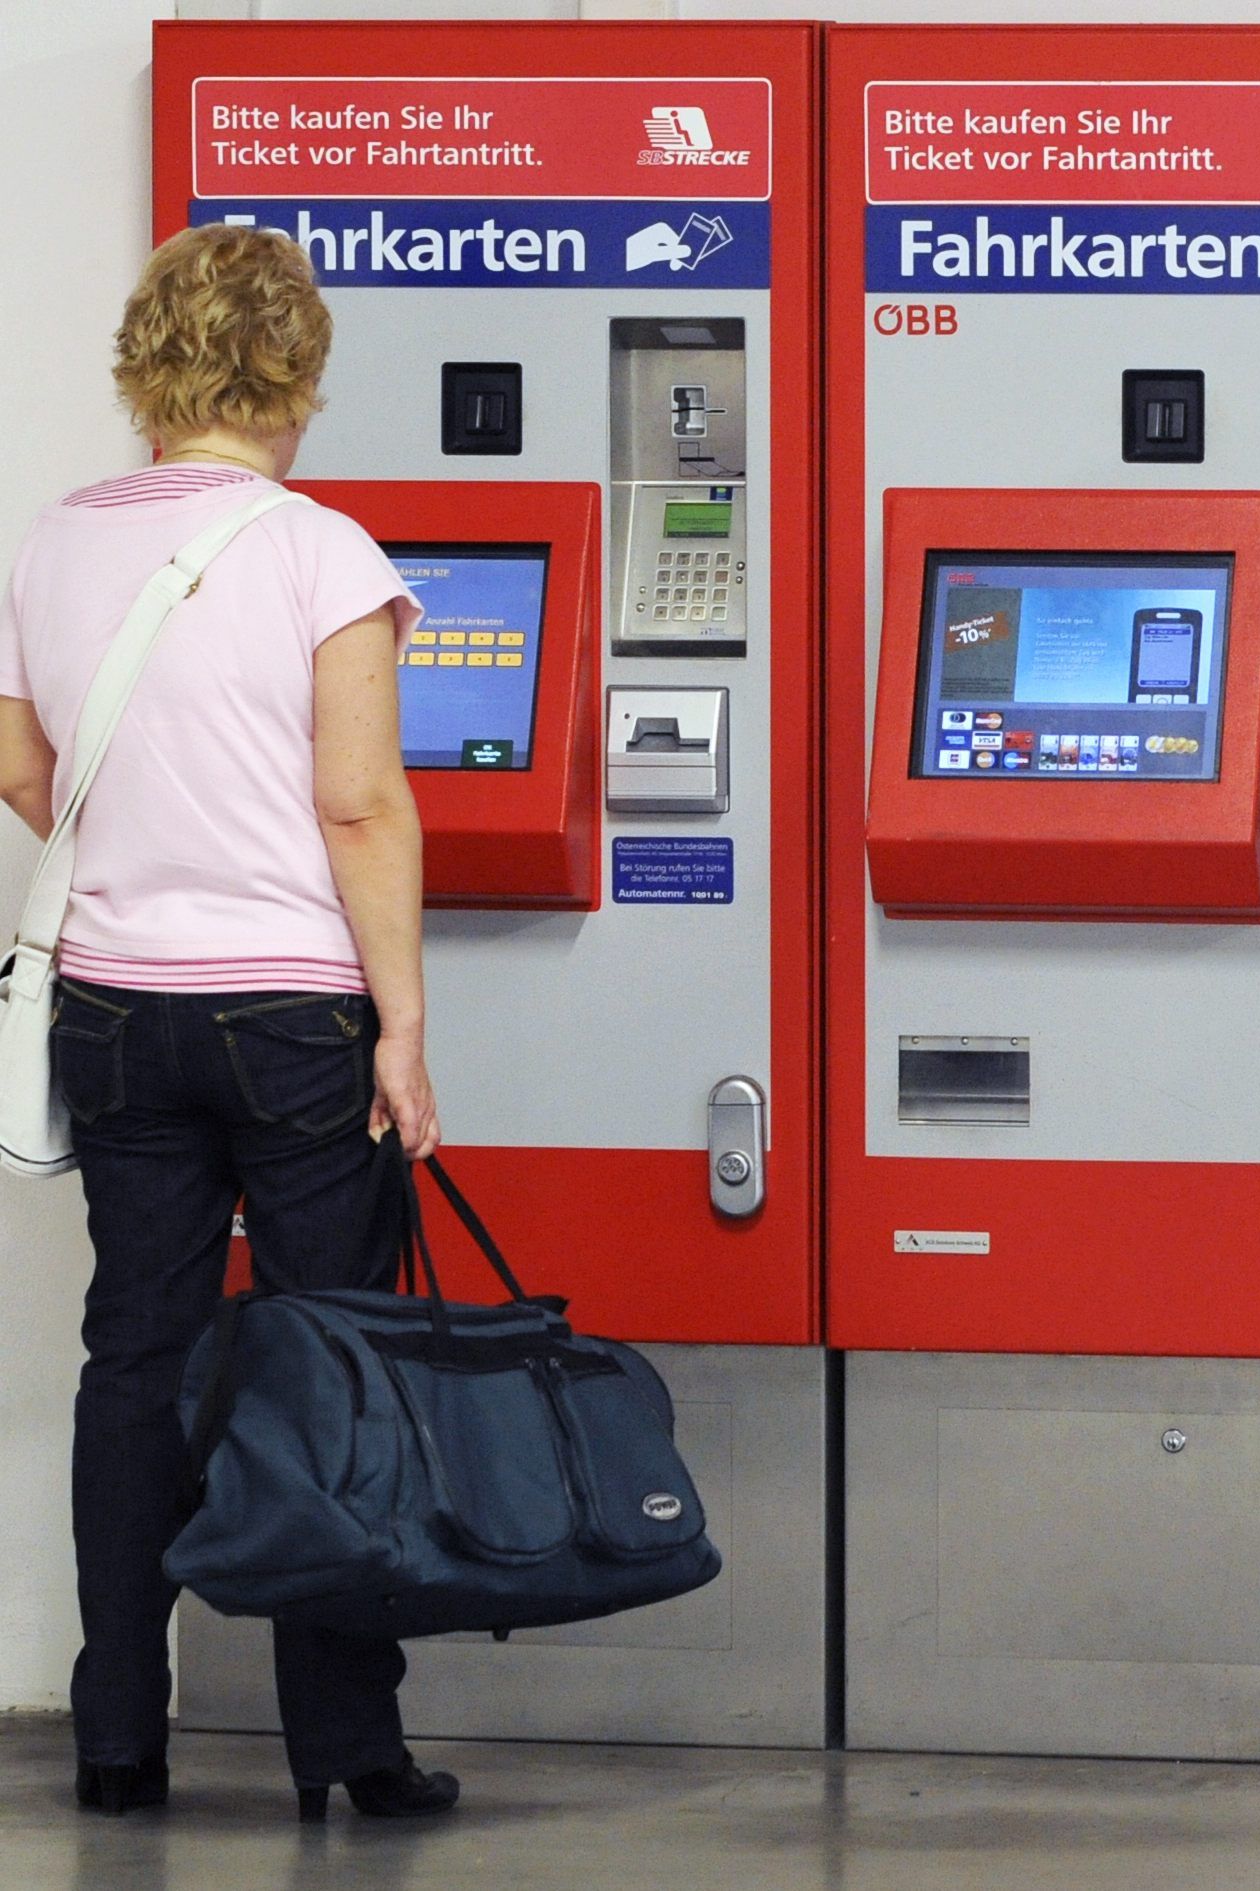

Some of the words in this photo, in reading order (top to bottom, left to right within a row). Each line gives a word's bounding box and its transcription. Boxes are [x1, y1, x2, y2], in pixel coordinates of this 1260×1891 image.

[213, 105, 279, 129] Bitte
[291, 104, 389, 129] kaufen
[401, 105, 443, 129] Sie
[455, 105, 493, 129] Ihr
[886, 110, 953, 134] Bitte
[965, 109, 1065, 134] kaufen
[1078, 110, 1120, 134] Sie
[1133, 109, 1172, 134] Ihr
[212, 140, 299, 165] Ticket
[309, 147, 356, 164] vor
[368, 141, 542, 165] Fahrtantritt.
[884, 145, 973, 170] Ticket
[984, 152, 1032, 169] vor
[1044, 145, 1221, 170] Fahrtantritt.
[225, 211, 586, 271] hrkarten
[874, 304, 959, 335] ÖBB
[620, 863, 633, 872] Bei
[635, 863, 667, 874] Störung
[669, 863, 690, 872] rufen
[692, 863, 704, 872] Sie
[706, 863, 725, 873] bitte
[682, 875, 692, 883] 05
[618, 889, 687, 898] Automatennr.
